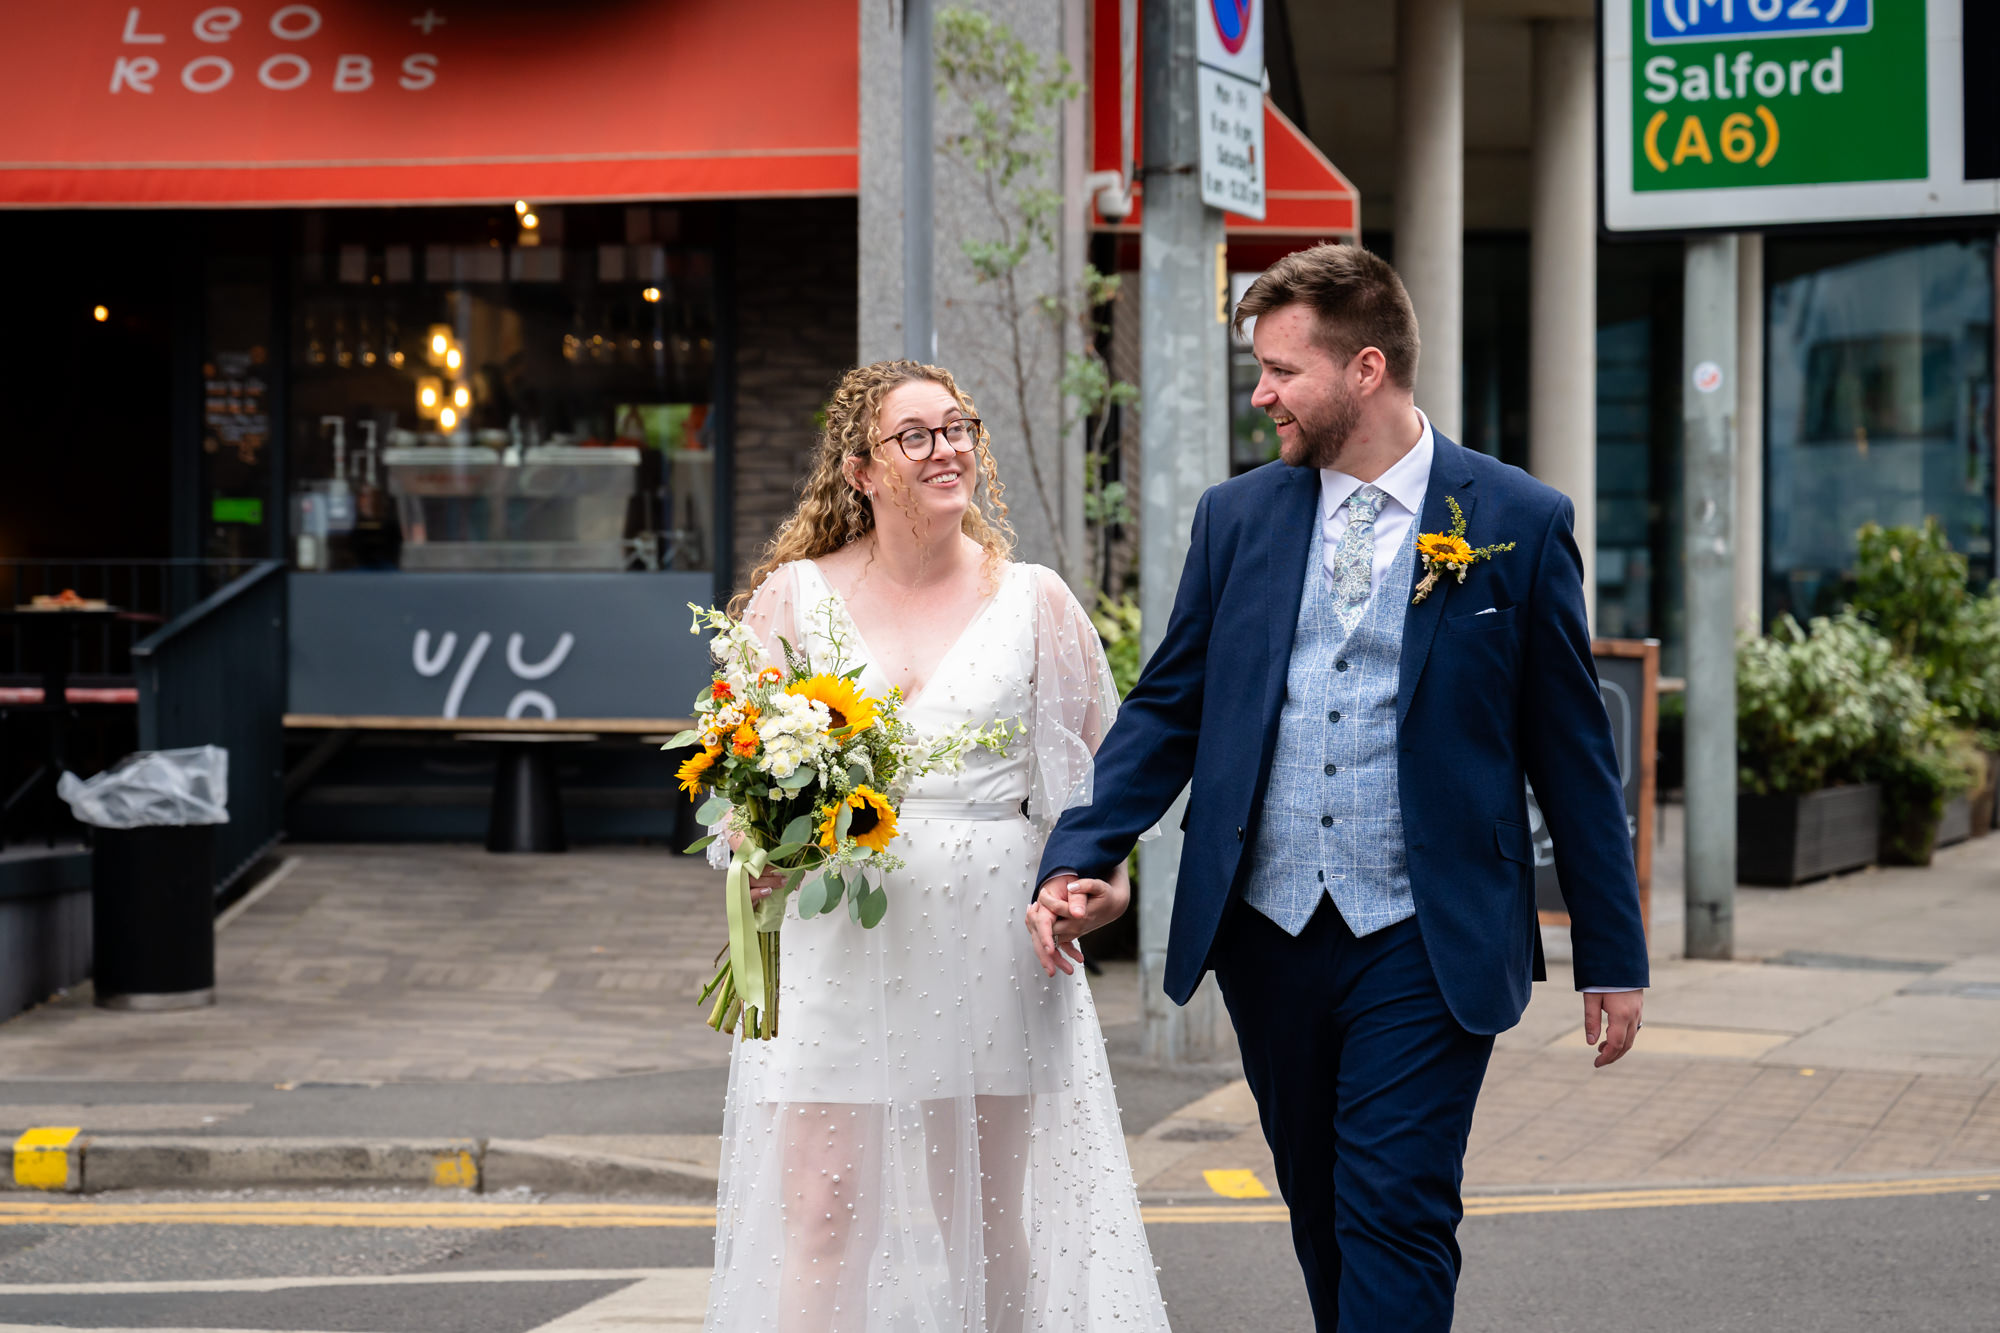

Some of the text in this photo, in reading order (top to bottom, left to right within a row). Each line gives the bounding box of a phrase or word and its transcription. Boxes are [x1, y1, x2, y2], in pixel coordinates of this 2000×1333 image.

[109, 53, 439, 94] ROOBS
[1643, 46, 1844, 104] Salford
[1643, 104, 1780, 173] (A6)
